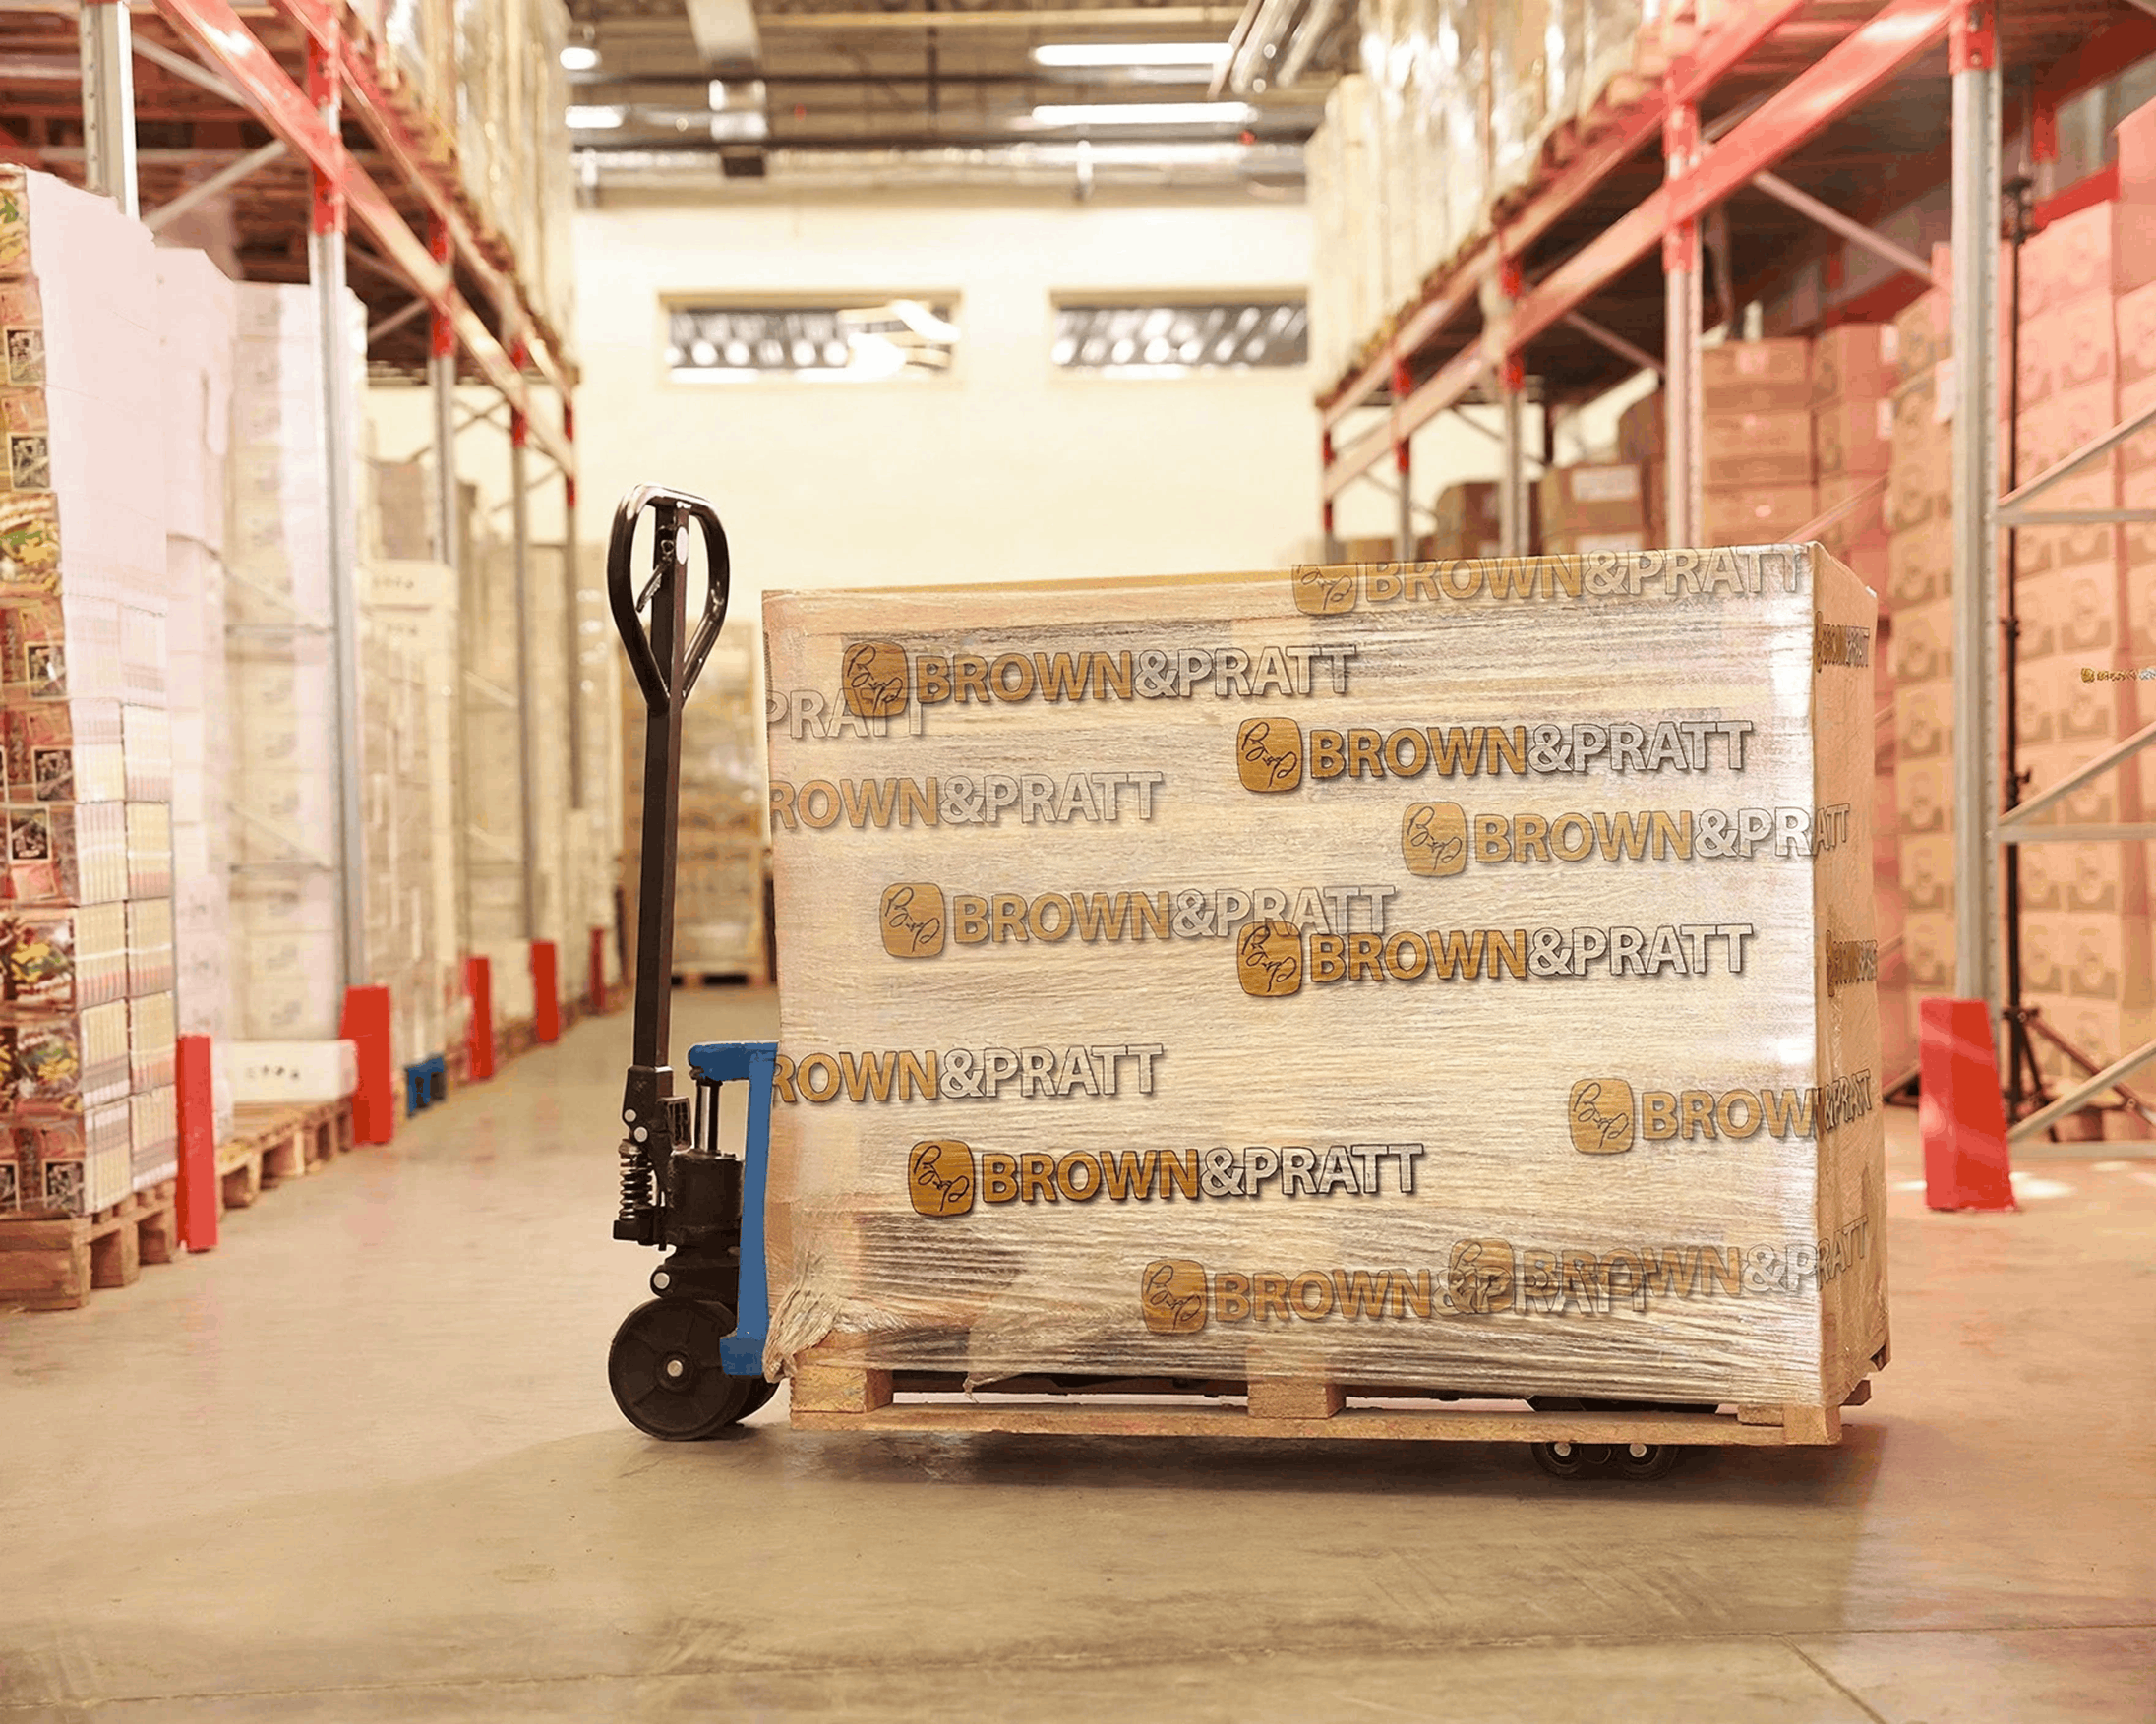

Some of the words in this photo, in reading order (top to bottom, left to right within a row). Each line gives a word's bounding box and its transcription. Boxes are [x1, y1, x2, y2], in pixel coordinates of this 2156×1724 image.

[1364, 545, 1808, 601] BROWN&PRATT
[916, 645, 1357, 704] BROWN&PRATT
[1310, 720, 1753, 778] BROWN&PRATT
[1474, 803, 1850, 863] BROWN&PRATT
[953, 885, 1396, 944] BROWN&PRATT
[1309, 923, 1753, 981] BROWN&PRATT
[982, 1141, 1424, 1204] BROWN&PRATT
